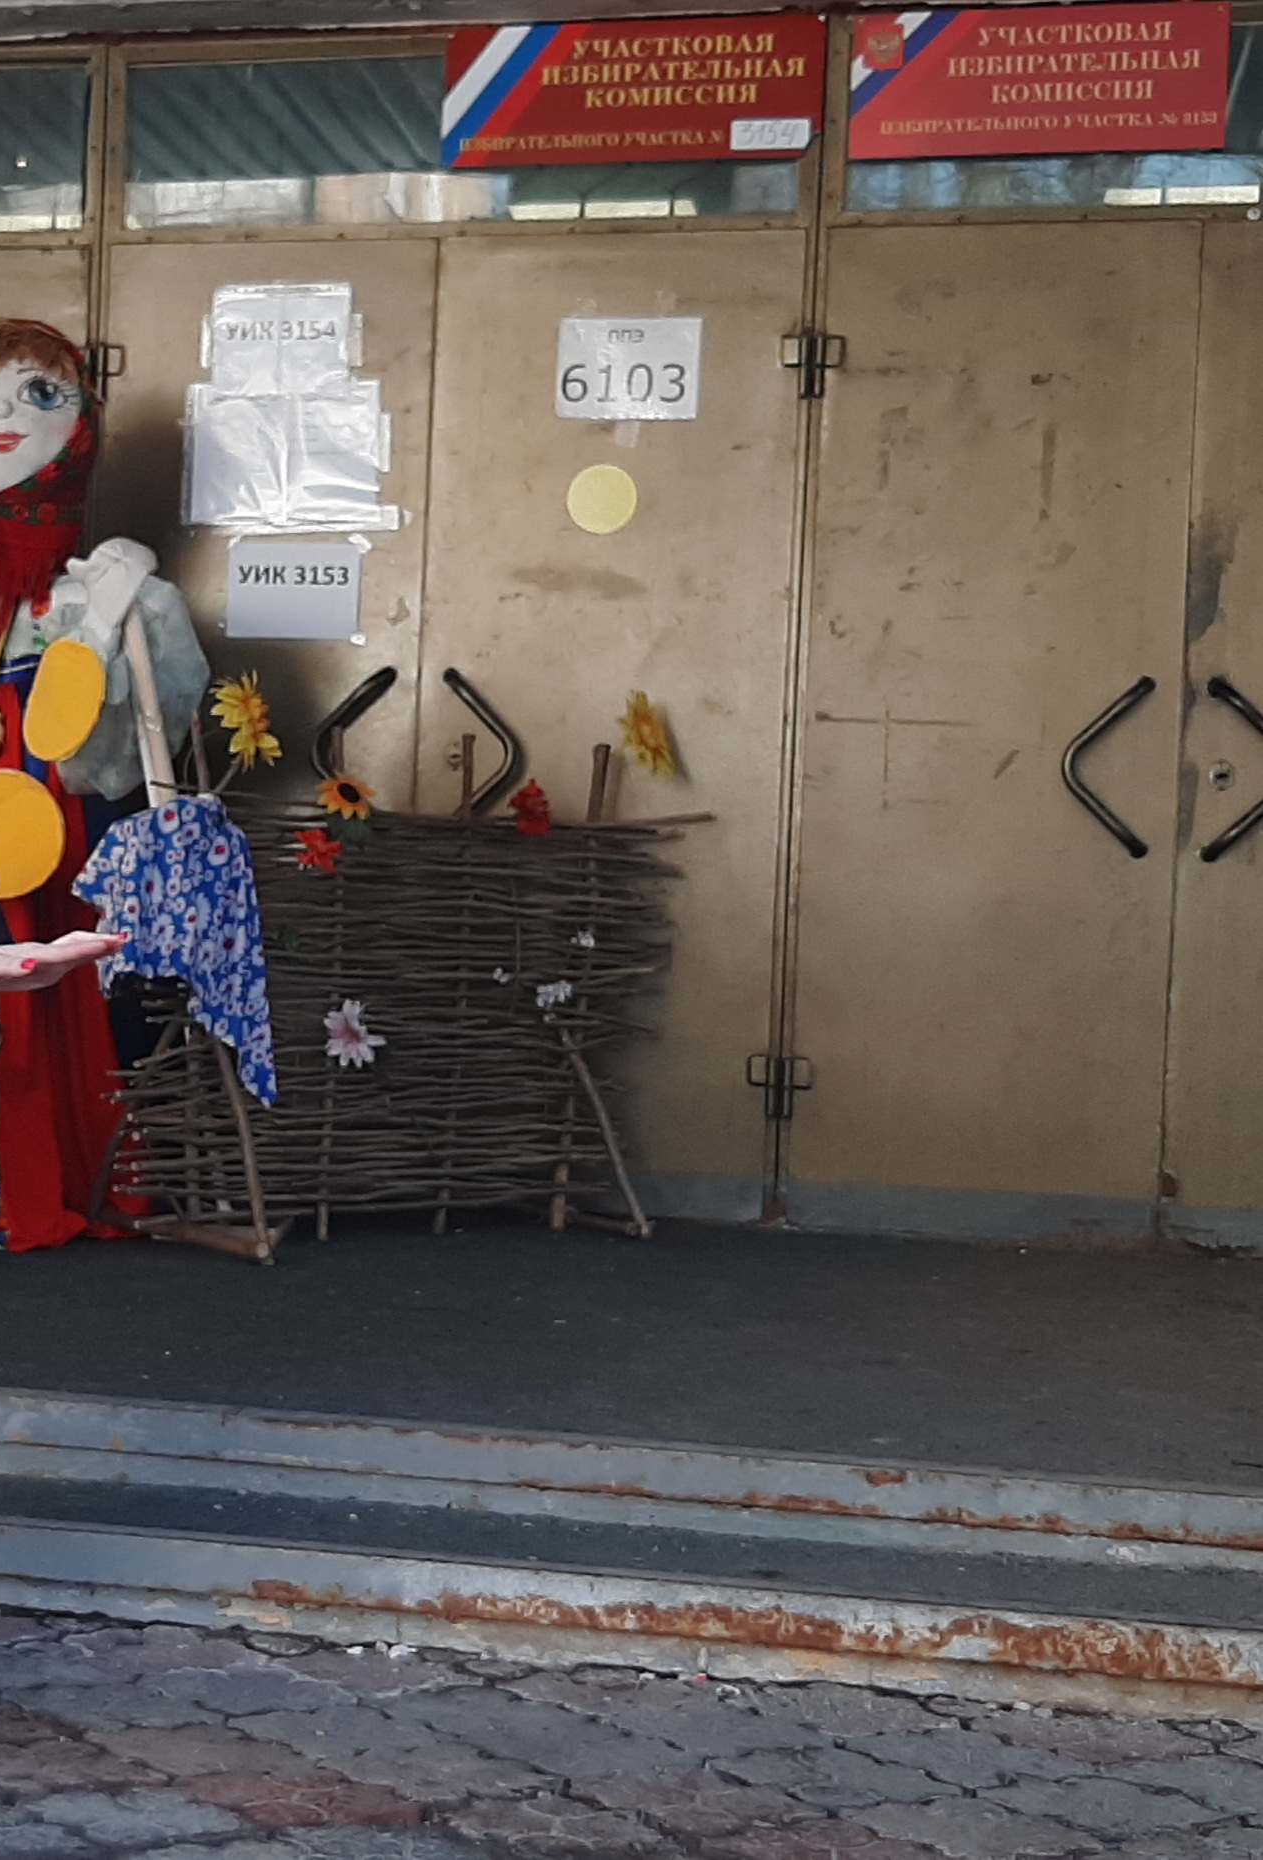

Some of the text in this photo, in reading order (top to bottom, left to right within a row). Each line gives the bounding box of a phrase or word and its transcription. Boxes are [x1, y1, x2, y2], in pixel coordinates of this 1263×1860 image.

[572, 33, 775, 60] УЧАСТКОВАЯ
[978, 20, 1173, 48] УЧАСТКОВАЯ
[541, 57, 806, 87] ИЗБИРАТЕЛЬНАЯ
[947, 48, 1202, 77] ИЗБИРАТЕЛЬНАЯ
[585, 83, 759, 110] КОМИССИЯ
[991, 78, 1155, 105] КОМИССИЯ
[1063, 112, 1153, 129] УЧАСТКА
[623, 129, 705, 147] УЧАСТКА
[225, 319, 337, 341] УИК 3154
[560, 362, 686, 403] 6103
[237, 564, 350, 586] УИК 3153
